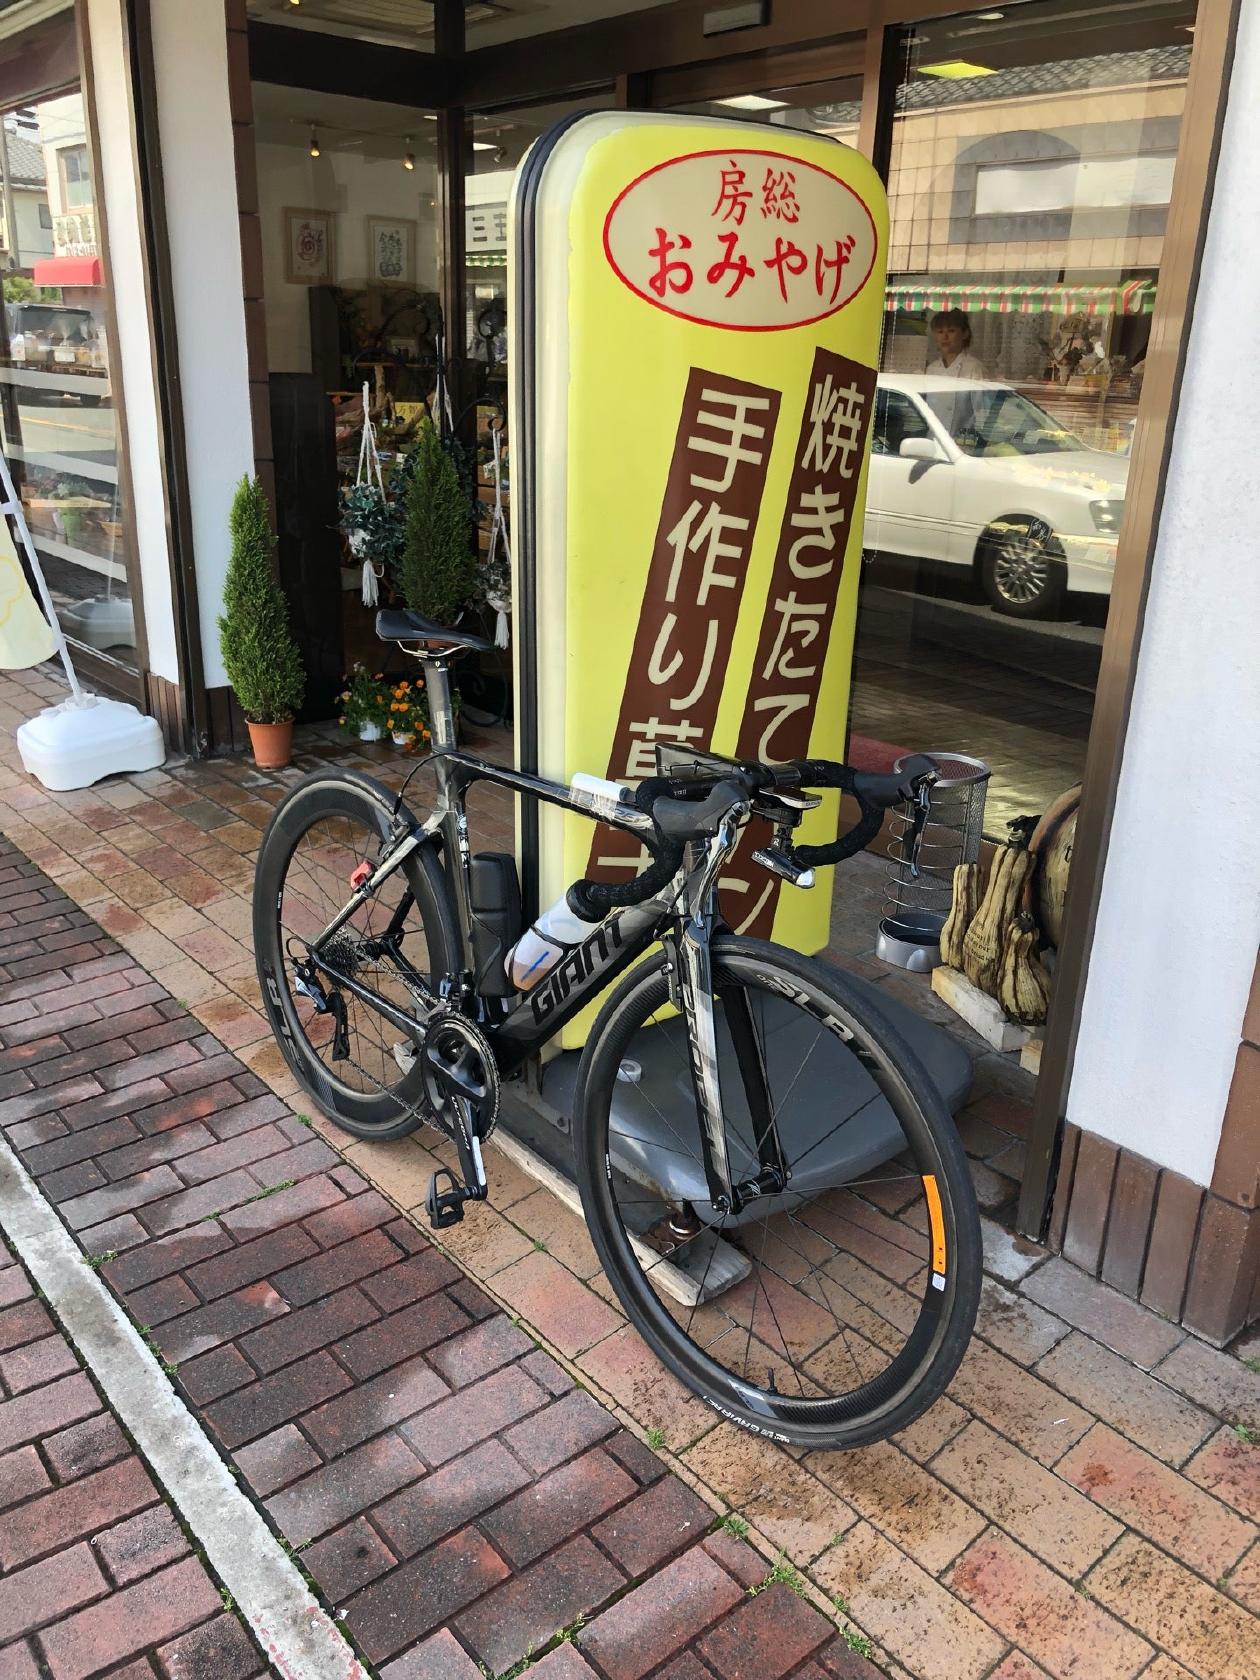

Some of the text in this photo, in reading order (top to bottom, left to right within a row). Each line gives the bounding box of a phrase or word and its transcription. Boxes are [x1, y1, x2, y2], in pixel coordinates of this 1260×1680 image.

[711, 159, 801, 225] 房総
[647, 228, 857, 306] おみやげ
[531, 910, 625, 1026] GIANT
[773, 976, 854, 1042] SLR
